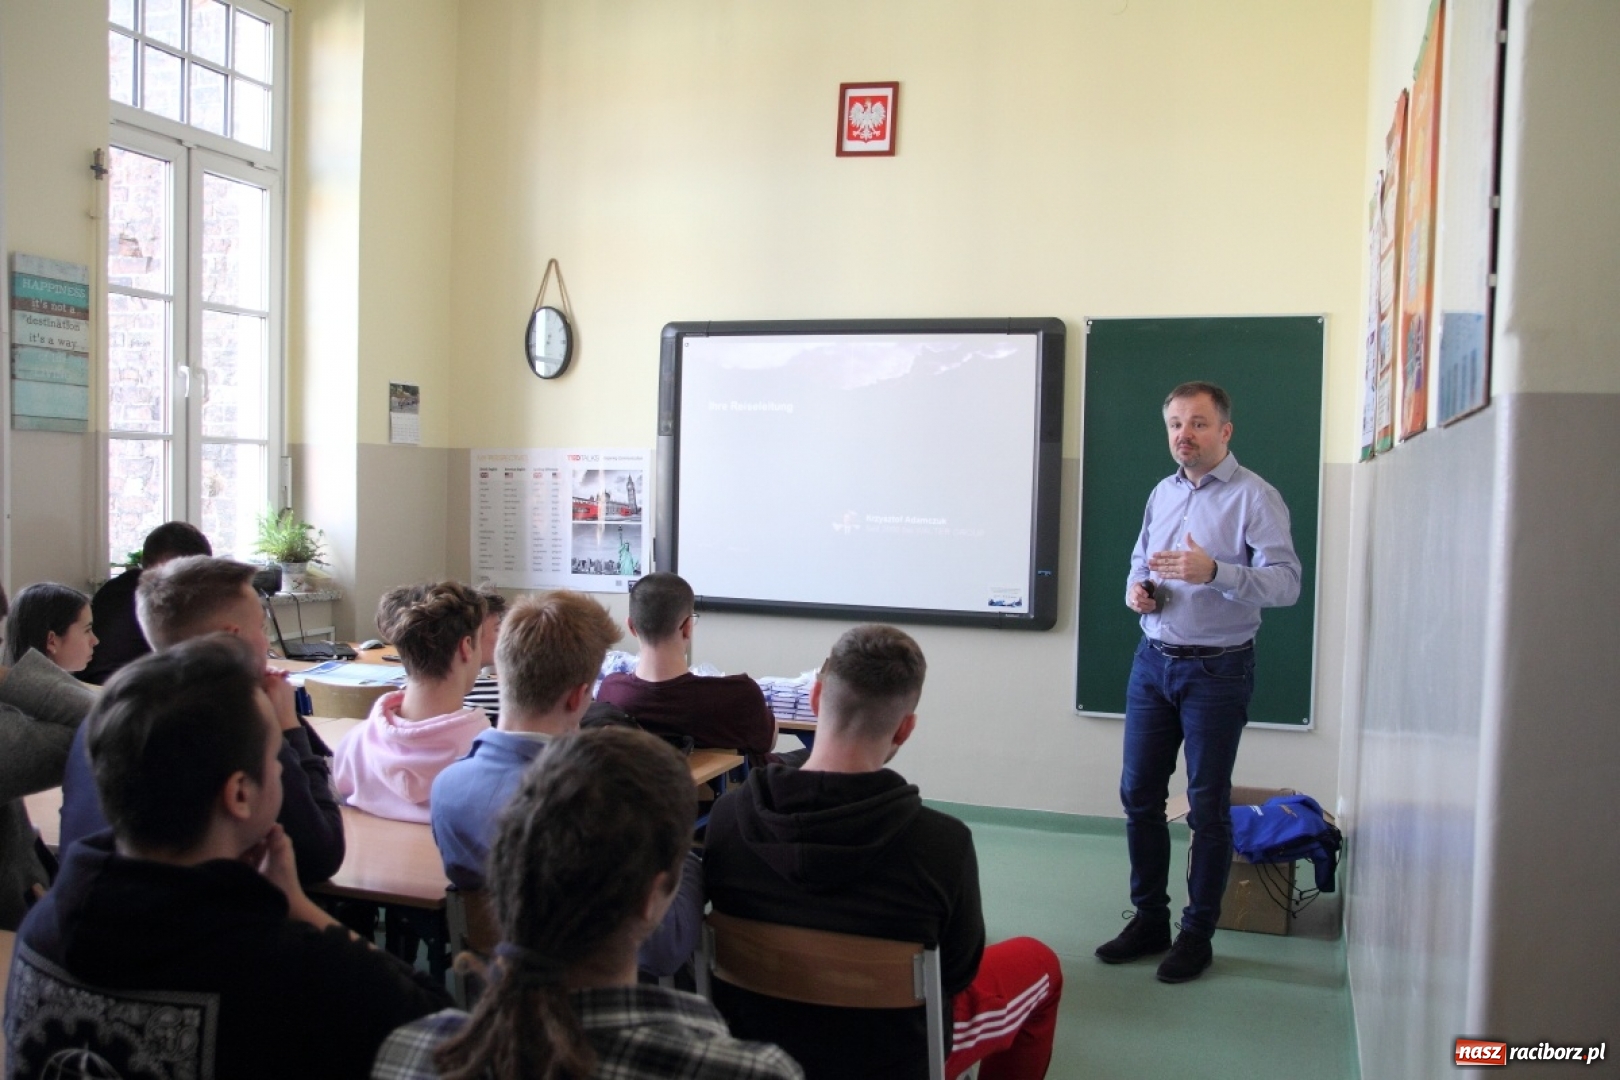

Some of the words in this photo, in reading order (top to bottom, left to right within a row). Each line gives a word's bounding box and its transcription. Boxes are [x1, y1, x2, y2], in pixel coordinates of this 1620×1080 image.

[23, 278, 86, 298] HAPPINESS
[31, 298, 48, 309] it's
[51, 302, 67, 311] not
[26, 315, 80, 331] destination
[29, 333, 45, 344] it's
[48, 337, 54, 345] a
[58, 338, 78, 349] way
